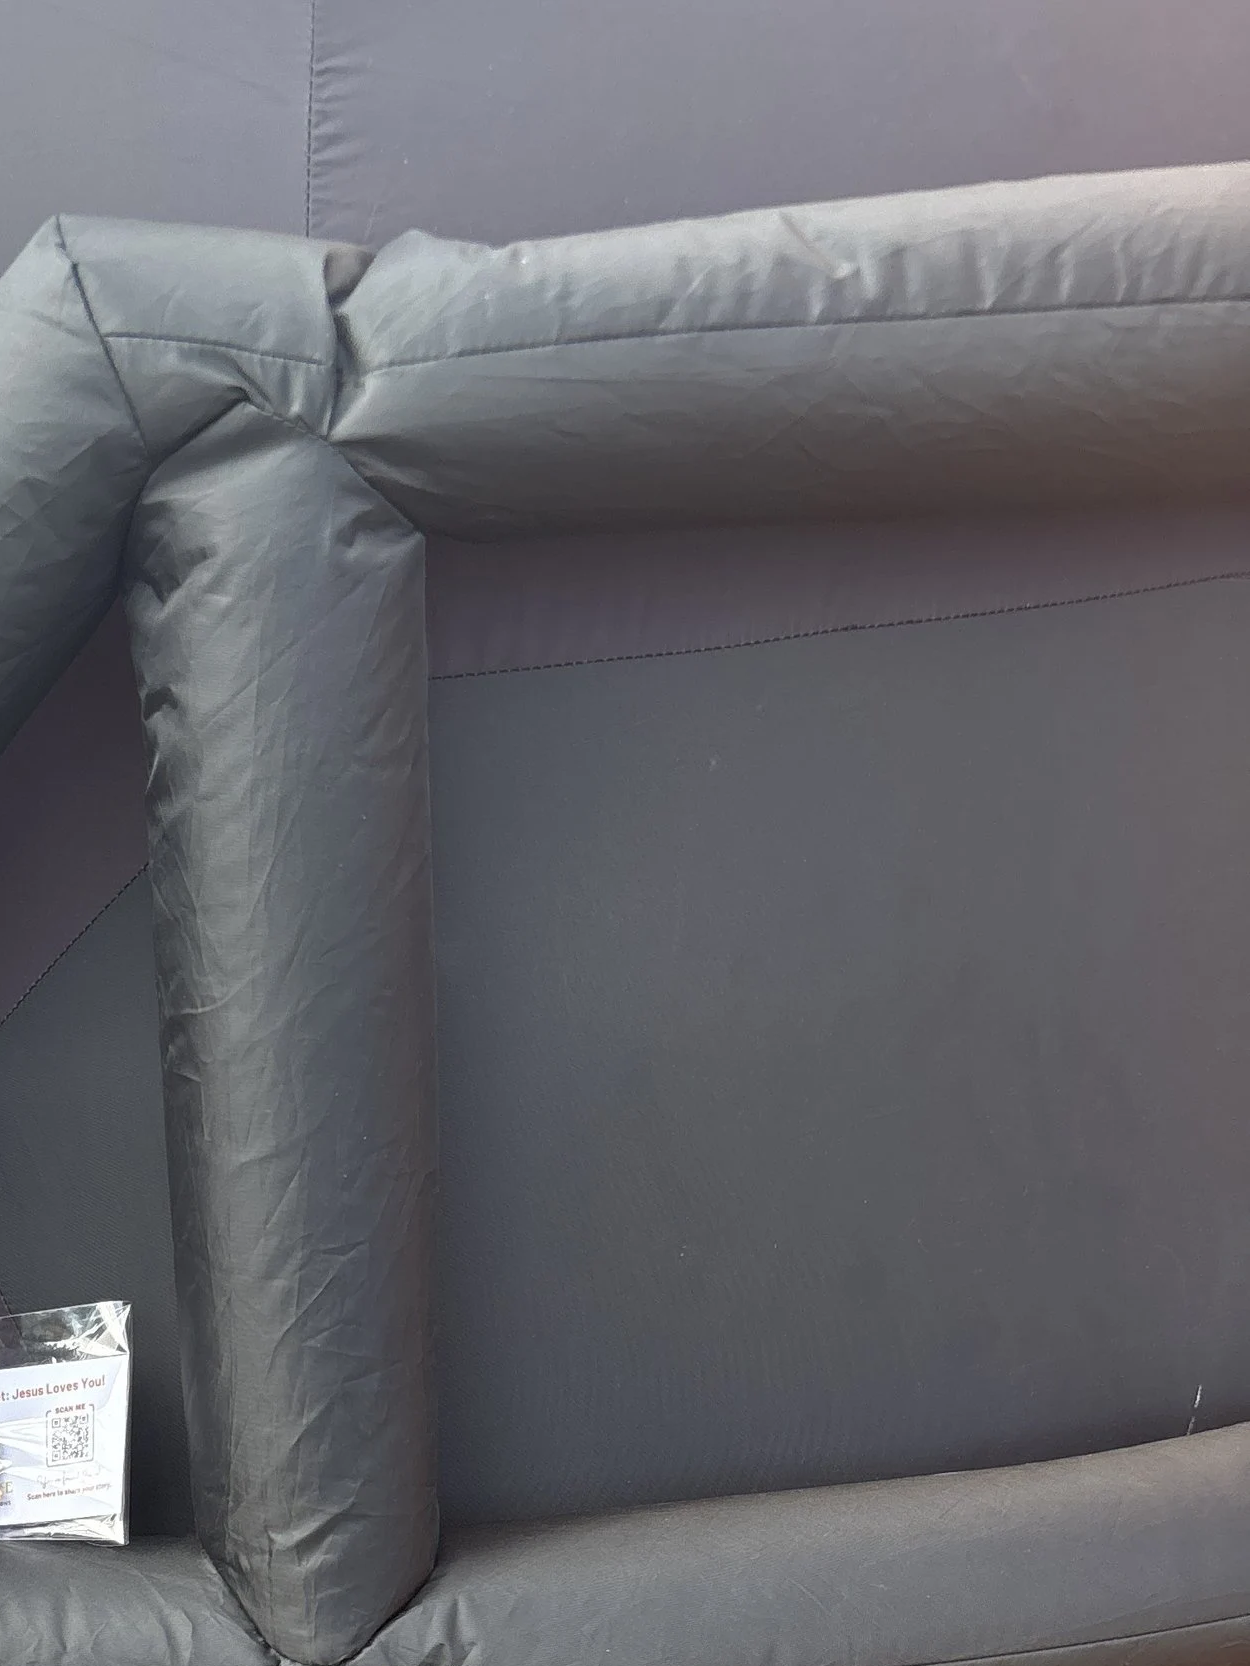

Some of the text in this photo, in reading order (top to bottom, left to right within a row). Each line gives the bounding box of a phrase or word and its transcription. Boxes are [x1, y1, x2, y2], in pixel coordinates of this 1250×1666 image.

[12, 1387, 44, 1400] Jesus
[45, 1380, 79, 1395] Loves
[81, 1375, 106, 1388] You!
[55, 1403, 86, 1414] SCAN ME
[27, 1493, 42, 1501] Scan
